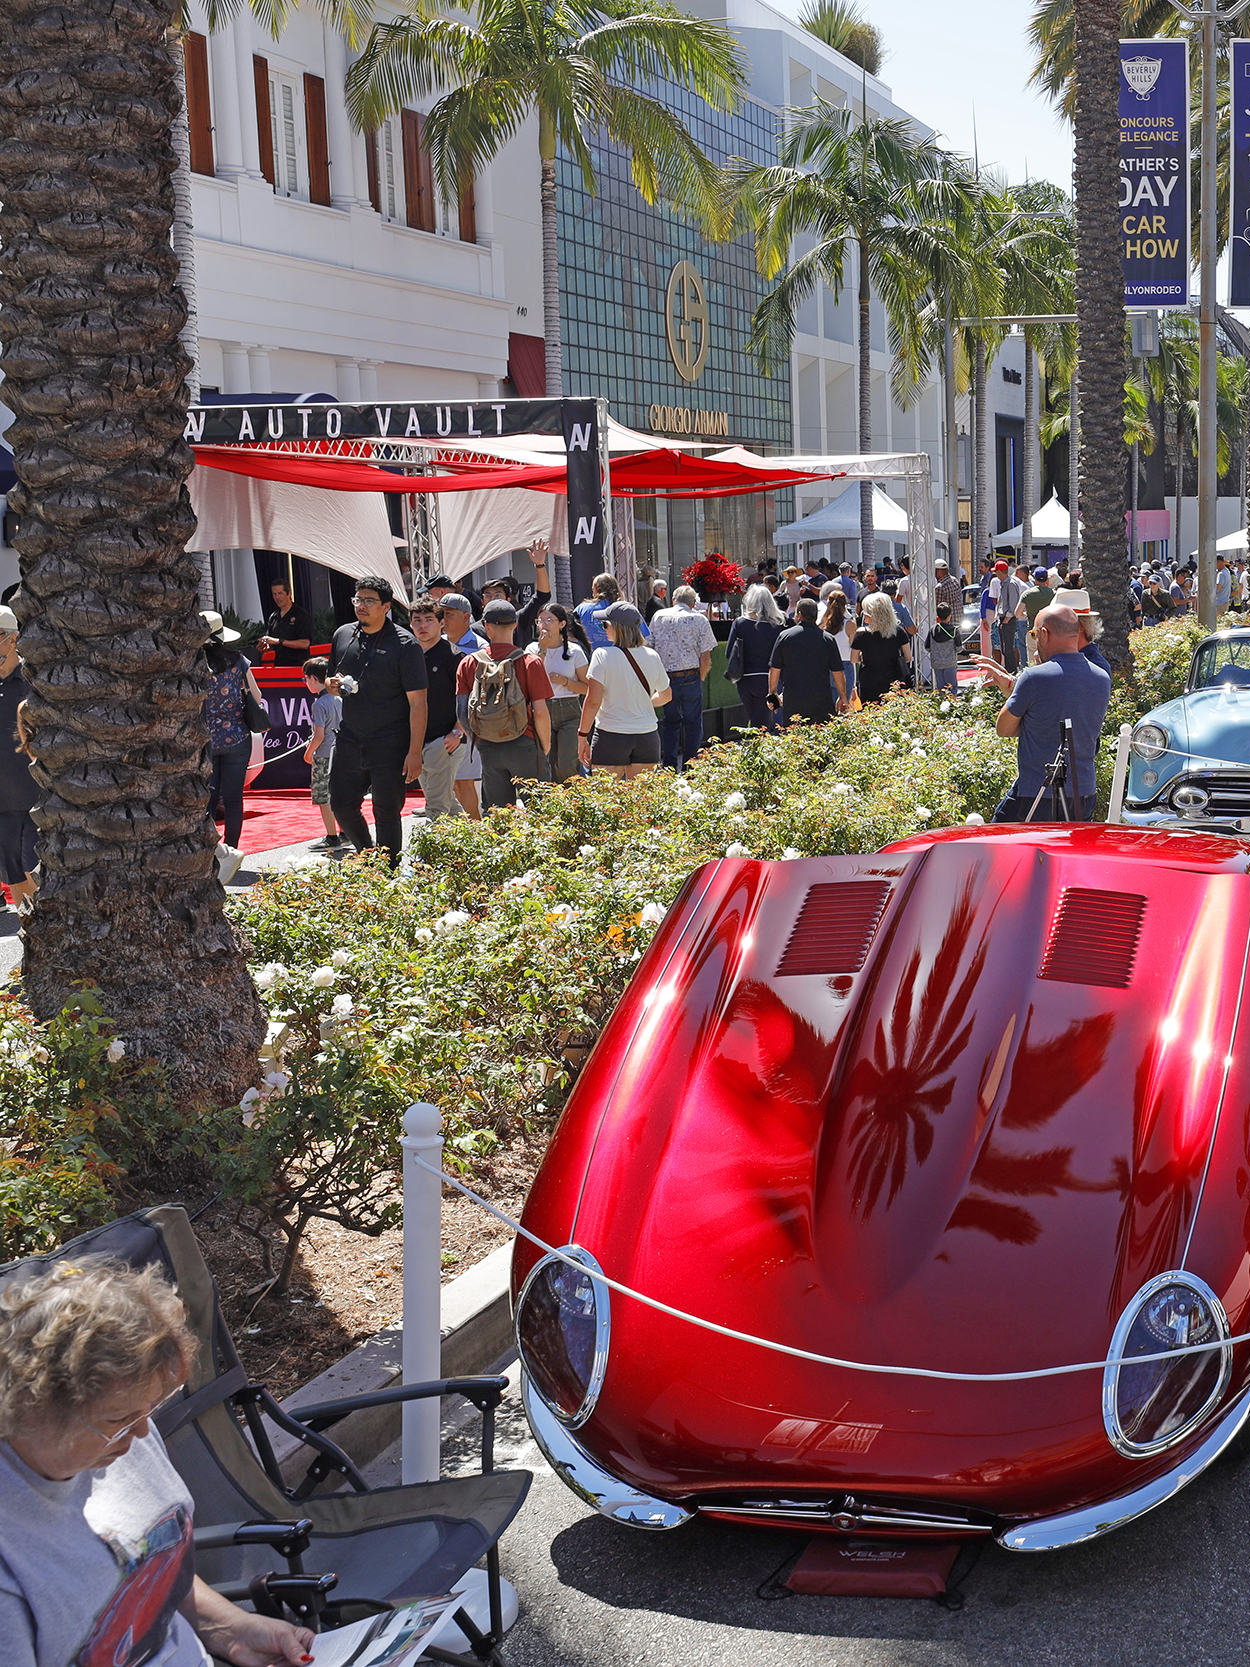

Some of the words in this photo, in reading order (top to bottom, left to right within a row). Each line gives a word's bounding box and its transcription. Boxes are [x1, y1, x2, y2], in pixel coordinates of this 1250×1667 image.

[1126, 66, 1156, 74] BEVERLY
[1132, 74, 1152, 82] HILLS
[1119, 117, 1174, 128] ONCOURS
[1120, 131, 1178, 142] ELEGANCE
[1118, 157, 1179, 172] ATHER'S
[1118, 176, 1178, 207] DAY
[1122, 215, 1166, 234] CAR
[1125, 238, 1180, 259] HOW
[238, 408, 342, 441] AUTO
[375, 404, 506, 436] VAULT
[650, 404, 692, 434] GIORGIO
[694, 408, 729, 436] ARMANI
[839, 1550, 906, 1558] WELSH
